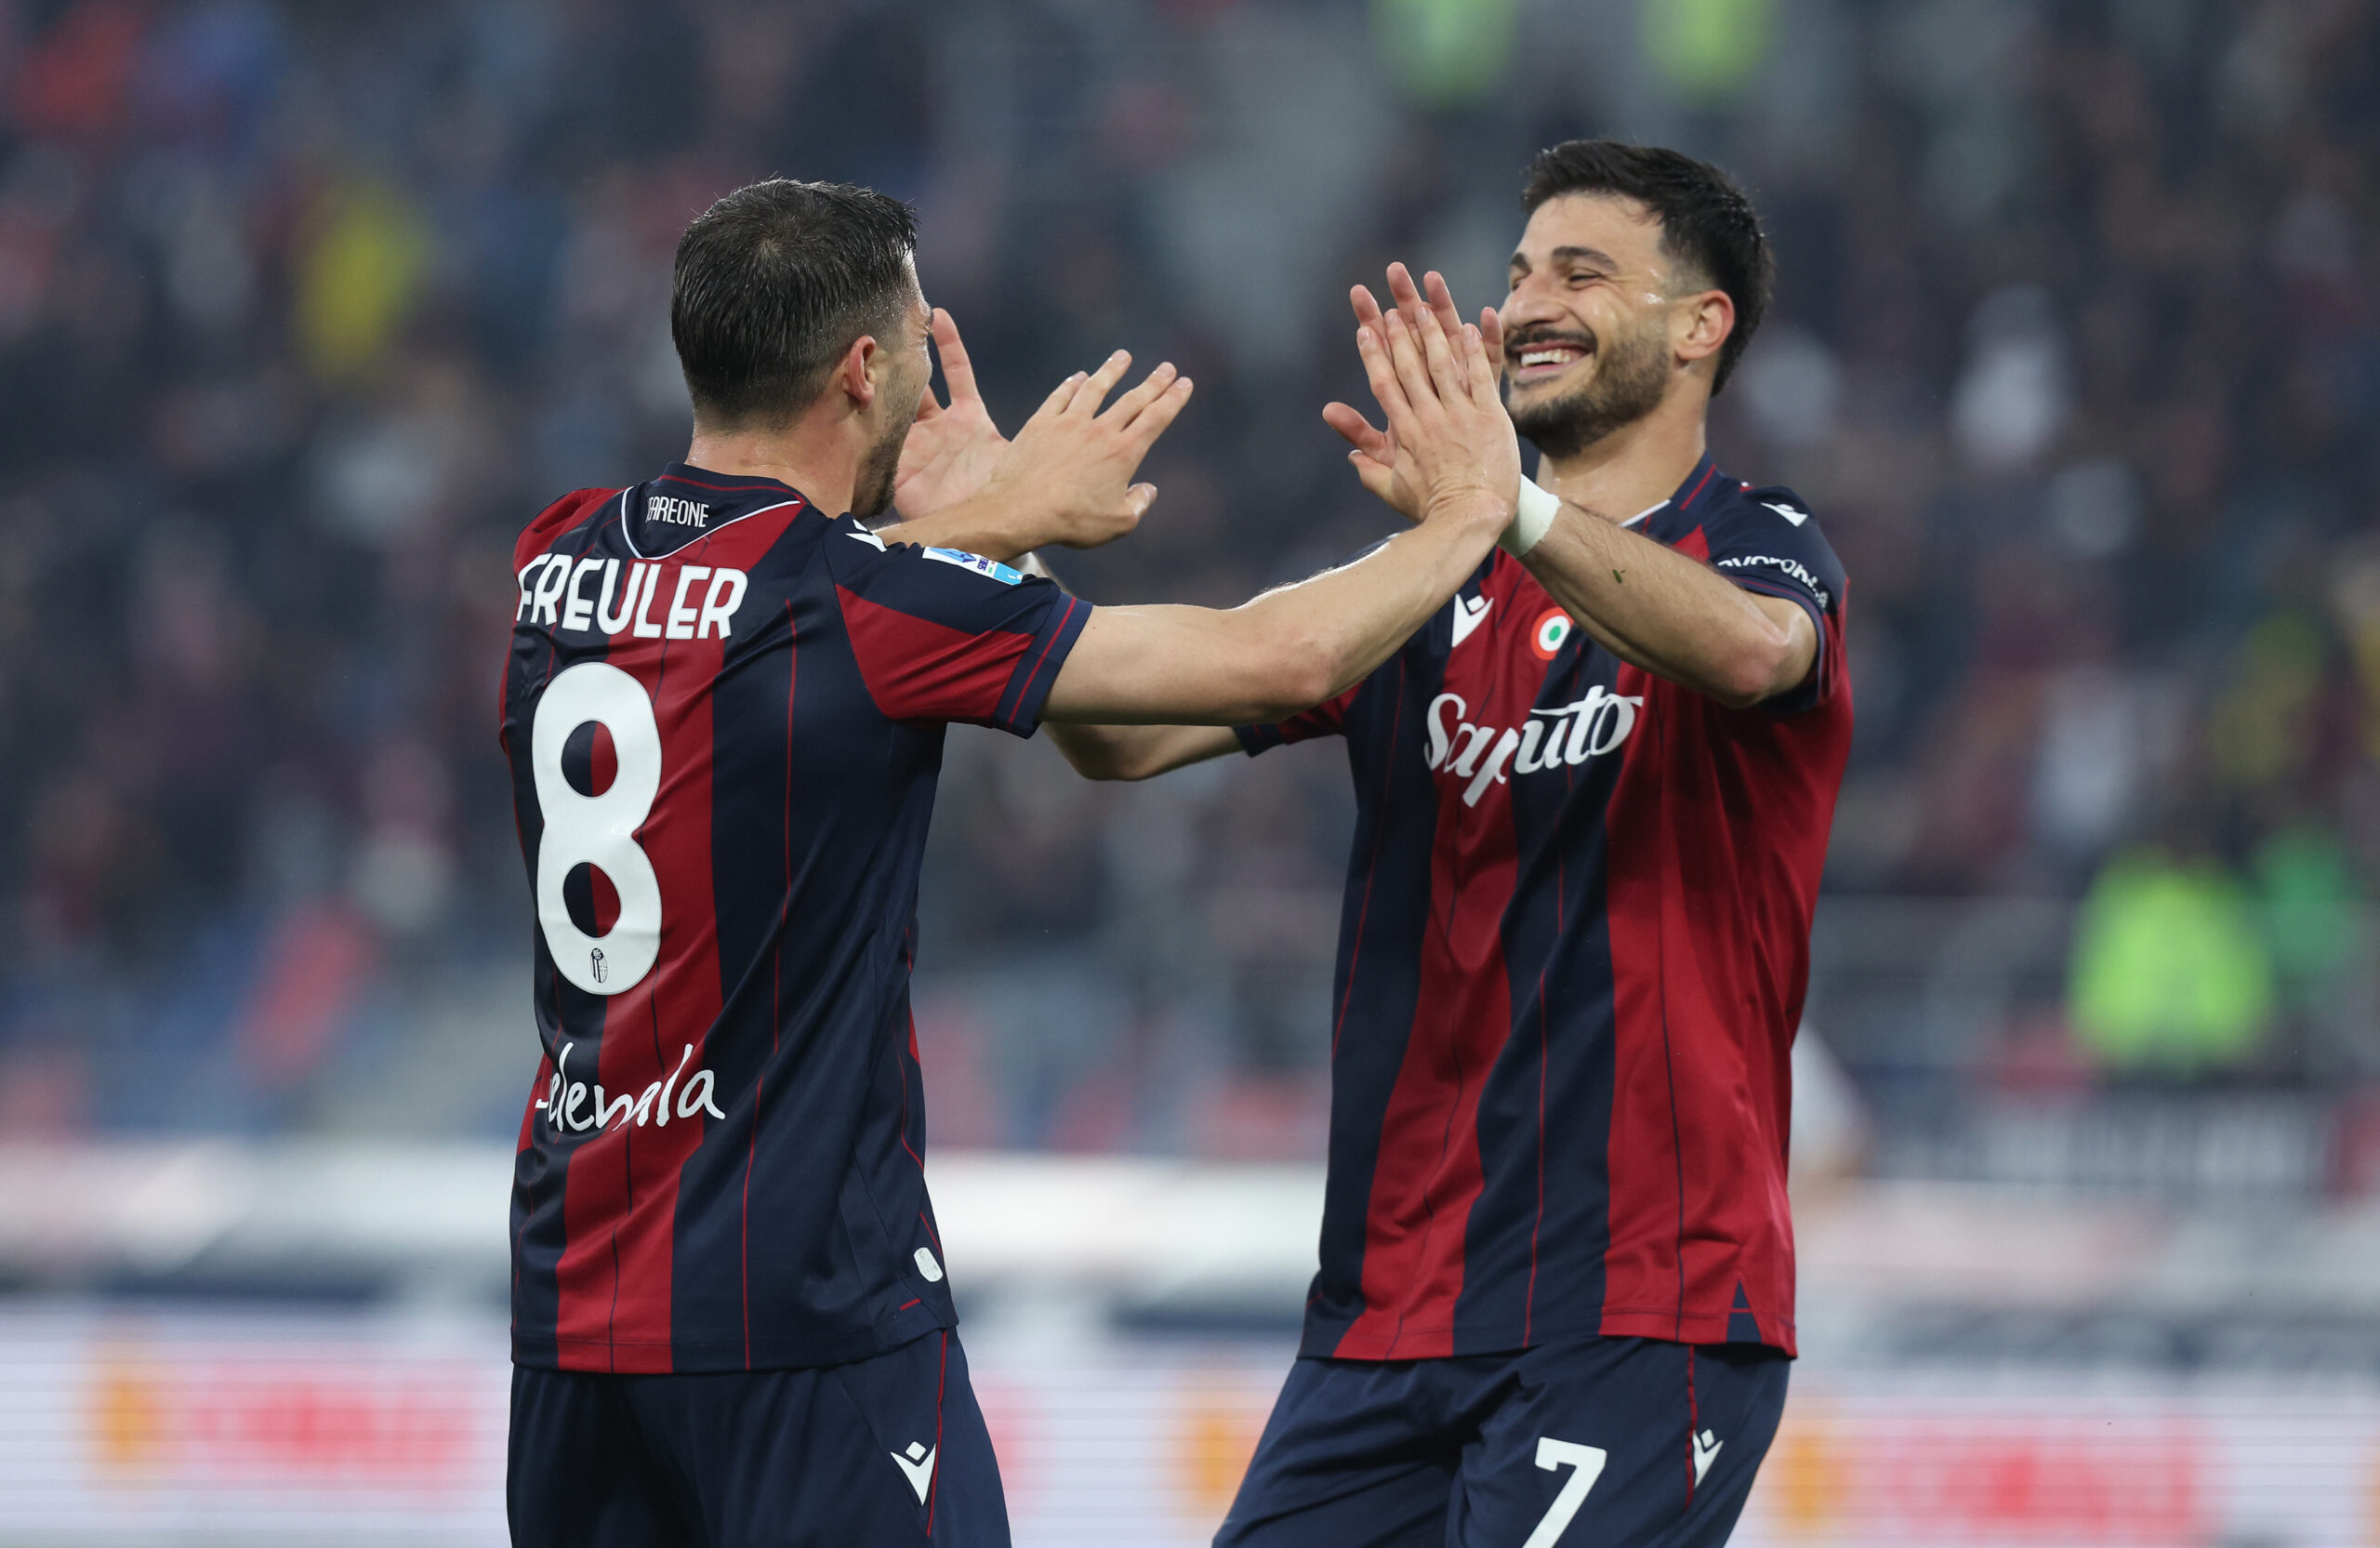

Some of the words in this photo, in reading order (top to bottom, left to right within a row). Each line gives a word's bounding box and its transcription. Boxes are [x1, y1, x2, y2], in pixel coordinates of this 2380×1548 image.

[516, 553, 748, 640] FREULER
[1424, 685, 1644, 808] Saputo
[532, 662, 662, 995] 8
[1522, 1436, 1606, 1548] 7
